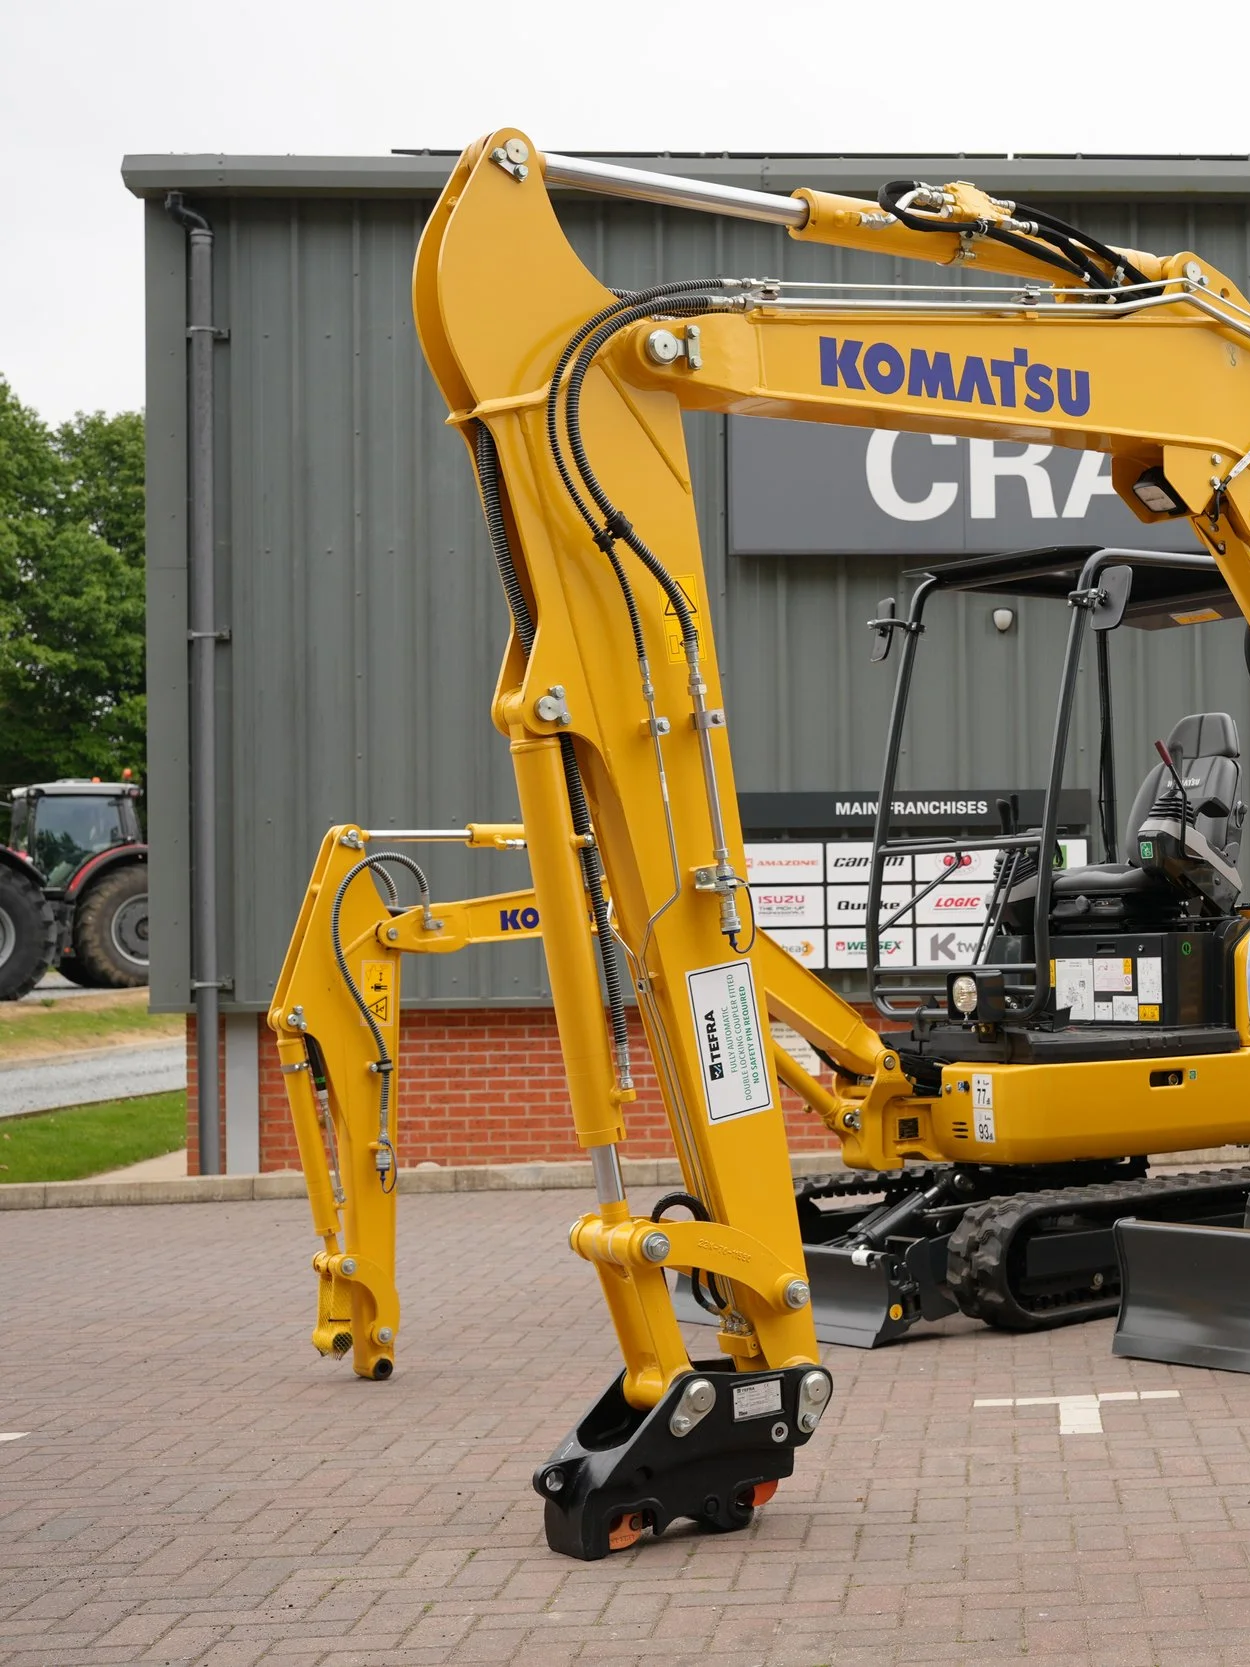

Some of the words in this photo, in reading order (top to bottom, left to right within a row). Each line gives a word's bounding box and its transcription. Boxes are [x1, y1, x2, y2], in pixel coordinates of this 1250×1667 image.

[818, 335, 1091, 417] KOMATSU
[835, 802, 879, 815] MAIN
[890, 801, 988, 815] RANCHISES
[758, 895, 805, 904] ISUZU
[934, 897, 981, 908] LOGIC
[726, 974, 737, 1000] FITTED
[730, 1000, 742, 1035] COUPLER
[738, 986, 751, 1027] REQUIRED
[704, 1009, 721, 1063] TEFRA
[721, 1007, 735, 1051] AUTOMATIC
[745, 1027, 753, 1043] PIN
[727, 1052, 738, 1073] FULLY
[735, 1036, 748, 1070] LOCKING
[747, 1044, 758, 1071] SAFETY
[741, 1070, 753, 1101] DOUBLE
[753, 1071, 760, 1084] NO
[976, 1088, 986, 1104] 77
[978, 1124, 989, 1140] 93
